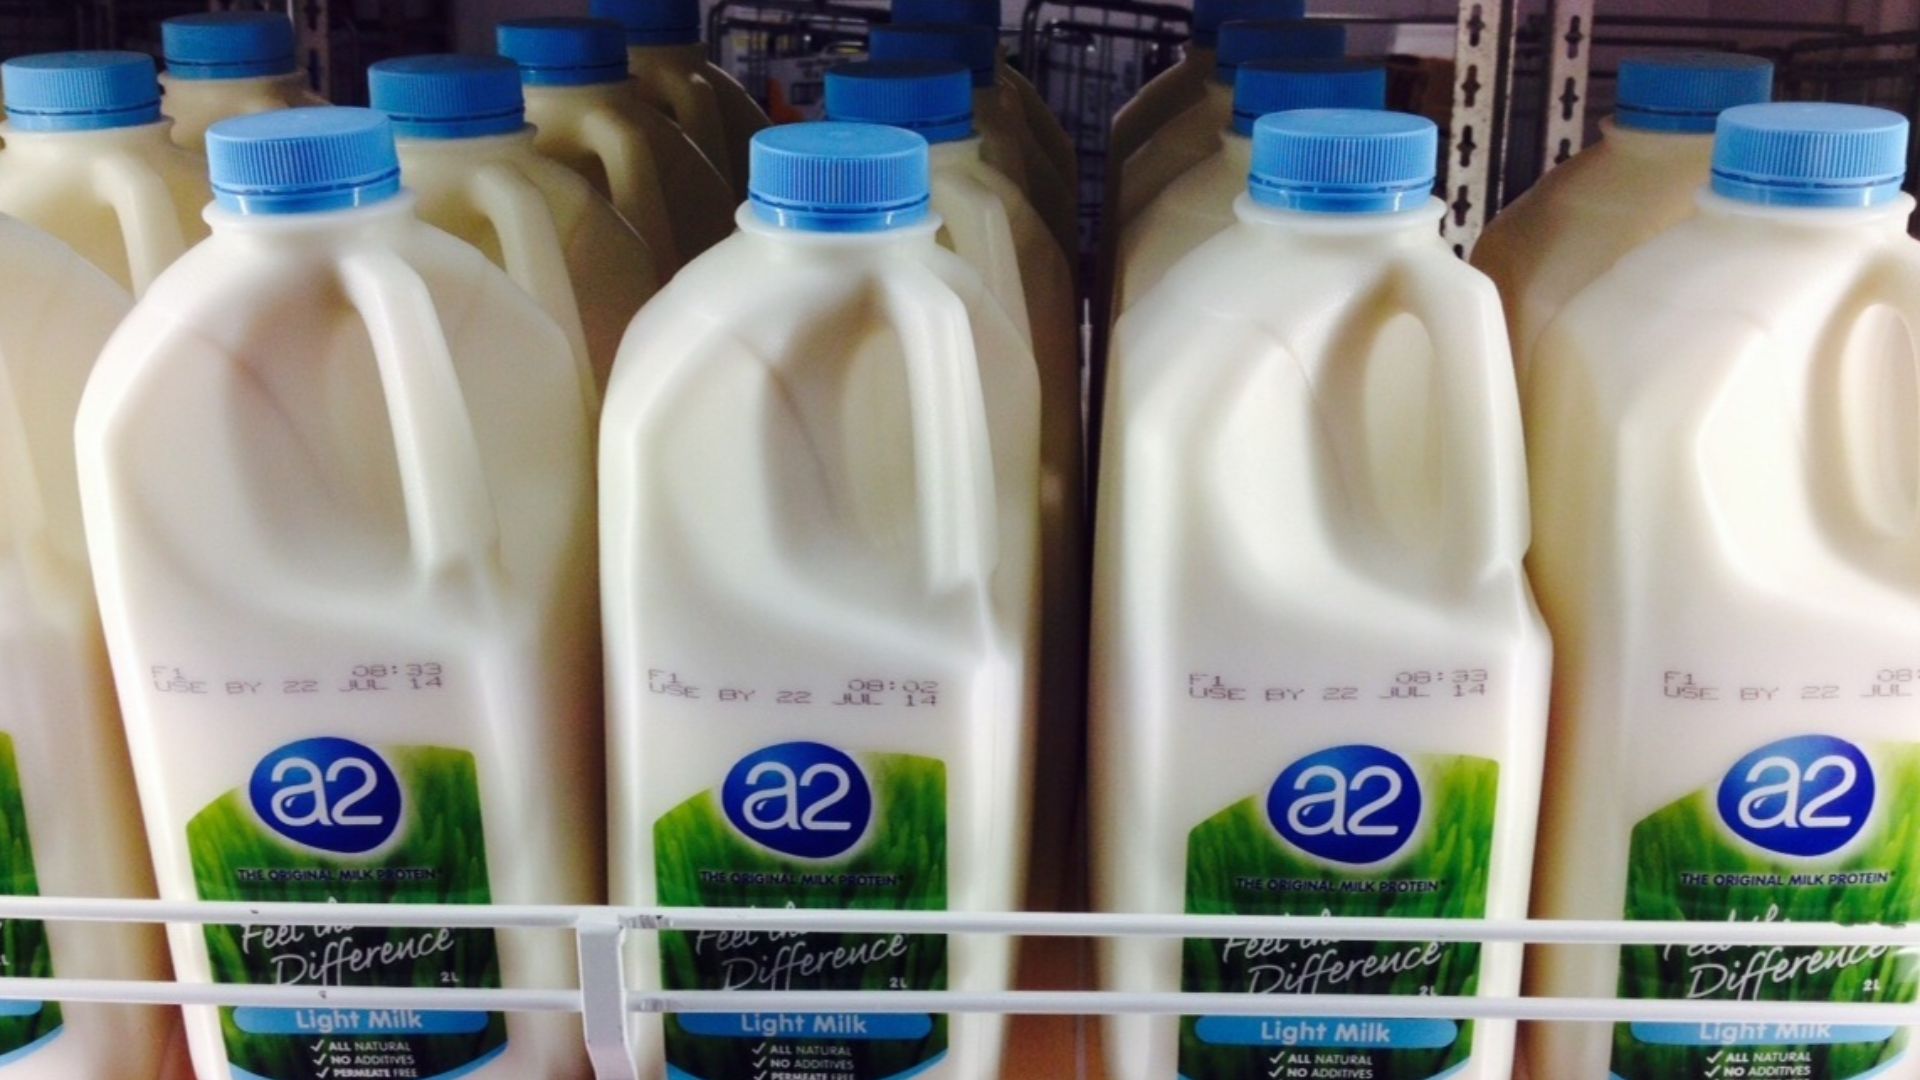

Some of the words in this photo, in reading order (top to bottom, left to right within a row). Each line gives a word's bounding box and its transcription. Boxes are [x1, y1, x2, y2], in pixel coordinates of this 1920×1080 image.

[352, 662, 442, 678] 08:33
[1189, 673, 1224, 687] F1
[1396, 669, 1488, 685] 08:33
[1664, 670, 1696, 685] F1
[154, 679, 208, 694] USE
[225, 681, 261, 695] BY
[283, 680, 318, 693] 22
[339, 678, 389, 692] JUL
[411, 676, 442, 690] 14
[648, 669, 678, 683] F1
[848, 679, 938, 694] 08:02
[649, 683, 699, 699] USE
[718, 689, 755, 701] BY
[777, 691, 812, 704] 22
[831, 693, 883, 706] JUL
[905, 694, 936, 707] 14
[1189, 687, 1246, 700] USE
[1265, 688, 1305, 701] BY
[1323, 687, 1358, 700] 22
[1379, 686, 1430, 699] JUL
[1453, 684, 1485, 697] 14
[1664, 685, 1719, 700] USE
[1740, 687, 1779, 700] BY
[1801, 686, 1840, 700] 22
[1860, 684, 1912, 698] JUL
[270, 756, 383, 827] a2
[742, 761, 852, 830] a2
[1738, 755, 1858, 829] a2
[1287, 765, 1403, 836] a2
[238, 869, 264, 880] THE
[268, 869, 335, 880] ORIGINAL
[340, 869, 373, 880] MILK
[701, 871, 726, 883] THE
[730, 872, 796, 885] ORIGINAL
[801, 874, 834, 885] MILK
[1680, 873, 1709, 885] THE
[1713, 873, 1783, 886] ORIGINAL
[1788, 873, 1824, 886] MILK
[1236, 878, 1264, 889] THE
[1267, 879, 1335, 892] ORIGINAL
[1340, 880, 1375, 893] MILK
[270, 927, 454, 986] Difference
[721, 934, 908, 991] Difference
[1248, 941, 1442, 994] Difference
[441, 971, 459, 982] 2L
[889, 978, 908, 989] 2L
[1863, 979, 1880, 992] 2L
[296, 1010, 360, 1033] Light
[368, 1010, 422, 1029] Milk
[741, 1013, 805, 1037] Light
[813, 1013, 867, 1034] Milk
[1261, 1021, 1327, 1046] Light
[1334, 1022, 1391, 1043] Milk
[1700, 1022, 1767, 1044] Light
[1775, 1023, 1831, 1039] Milk
[328, 1041, 351, 1051] ALL
[354, 1041, 411, 1052] NATURAL
[770, 1045, 792, 1055] ALL
[796, 1046, 852, 1056] NATURAL
[330, 1055, 351, 1064] NO
[354, 1054, 415, 1065] ADDITIVES
[770, 1059, 790, 1068] NO
[794, 1060, 854, 1070] ADDITIVES
[1287, 1054, 1311, 1064] ALL
[1314, 1055, 1373, 1065] NATURAL
[1725, 1052, 1748, 1062] ALL
[1753, 1052, 1811, 1062] NATURAL
[333, 1068, 391, 1078] PERMEATE
[393, 1069, 417, 1078] FREE
[1286, 1068, 1308, 1077] NO
[1311, 1068, 1373, 1079] ADDITIVES
[1723, 1067, 1745, 1077] NO
[1748, 1066, 1810, 1077] ADDITIVES
